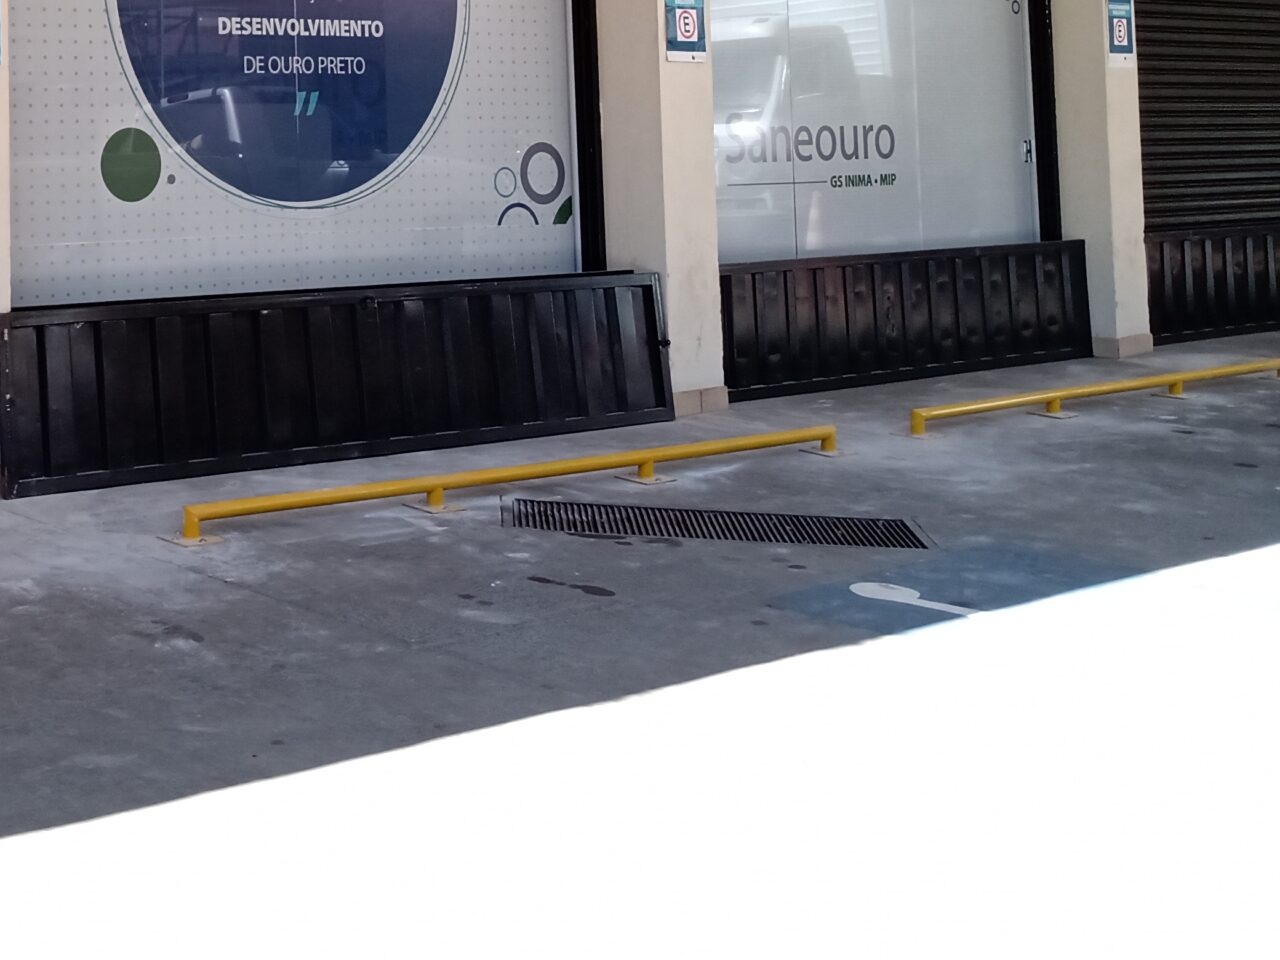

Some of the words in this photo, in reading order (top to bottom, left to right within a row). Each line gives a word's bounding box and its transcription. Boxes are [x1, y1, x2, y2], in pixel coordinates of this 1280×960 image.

[218, 17, 384, 38] DESENVOLVIMENTO
[683, 16, 691, 33] E
[243, 56, 265, 74] DE
[268, 56, 314, 74] OURO
[318, 56, 365, 75] PRETO
[725, 112, 896, 164] Saneouro
[830, 174, 843, 188] GS
[845, 174, 873, 188] INIMA
[880, 173, 897, 186] MIP
